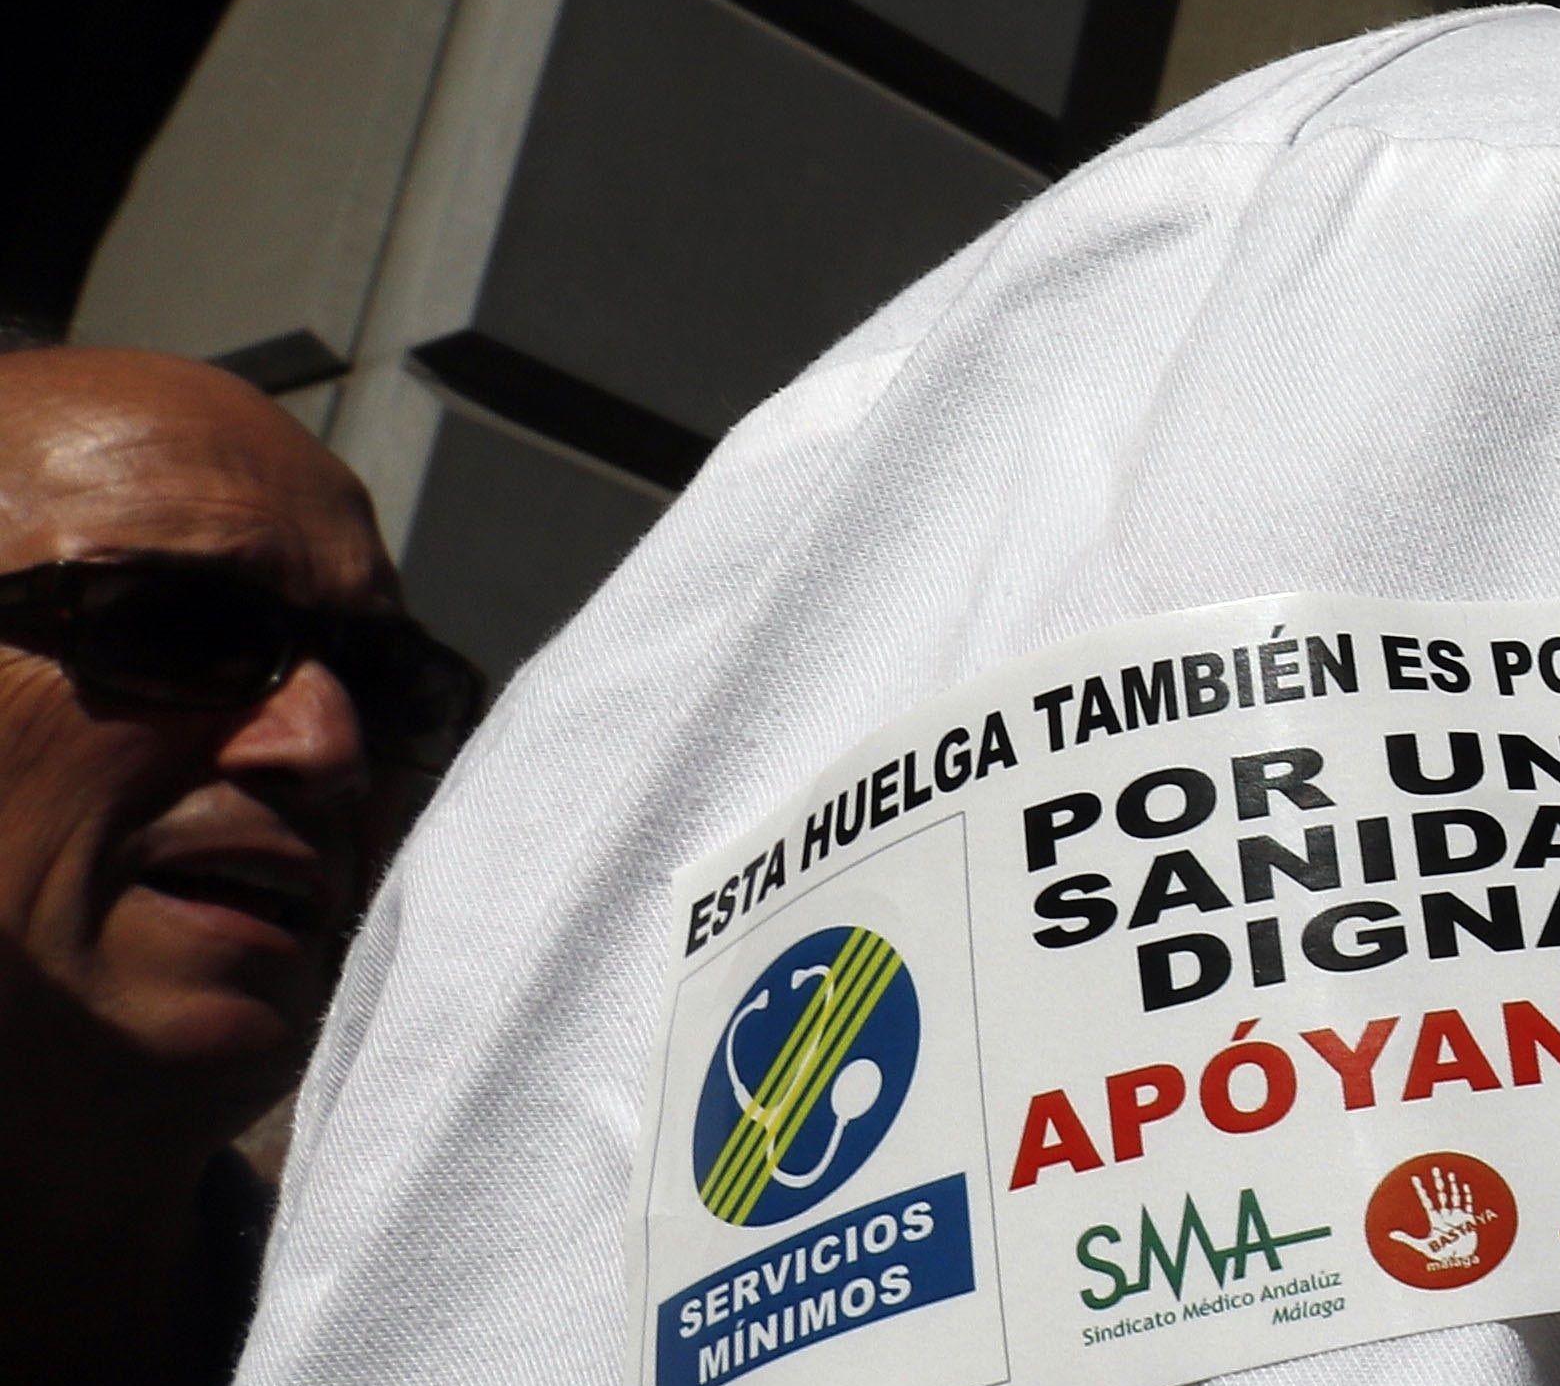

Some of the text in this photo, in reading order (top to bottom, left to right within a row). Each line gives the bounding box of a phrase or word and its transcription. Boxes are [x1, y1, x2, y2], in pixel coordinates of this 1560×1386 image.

[686, 855, 786, 956] ESTA
[801, 713, 1018, 874] HUELGA
[1033, 626, 1359, 753] TAMBIÉN
[1385, 633, 1472, 695] ES
[1023, 746, 1328, 872] POR
[678, 1200, 934, 1341] SERVICIOS
[1076, 1188, 1332, 1310] SMA
[1272, 1296, 1345, 1325] Málaga
[697, 1262, 911, 1385] MÍNIMOS
[1083, 1310, 1176, 1346] Sindicato
[1183, 1292, 1255, 1321] Médico
